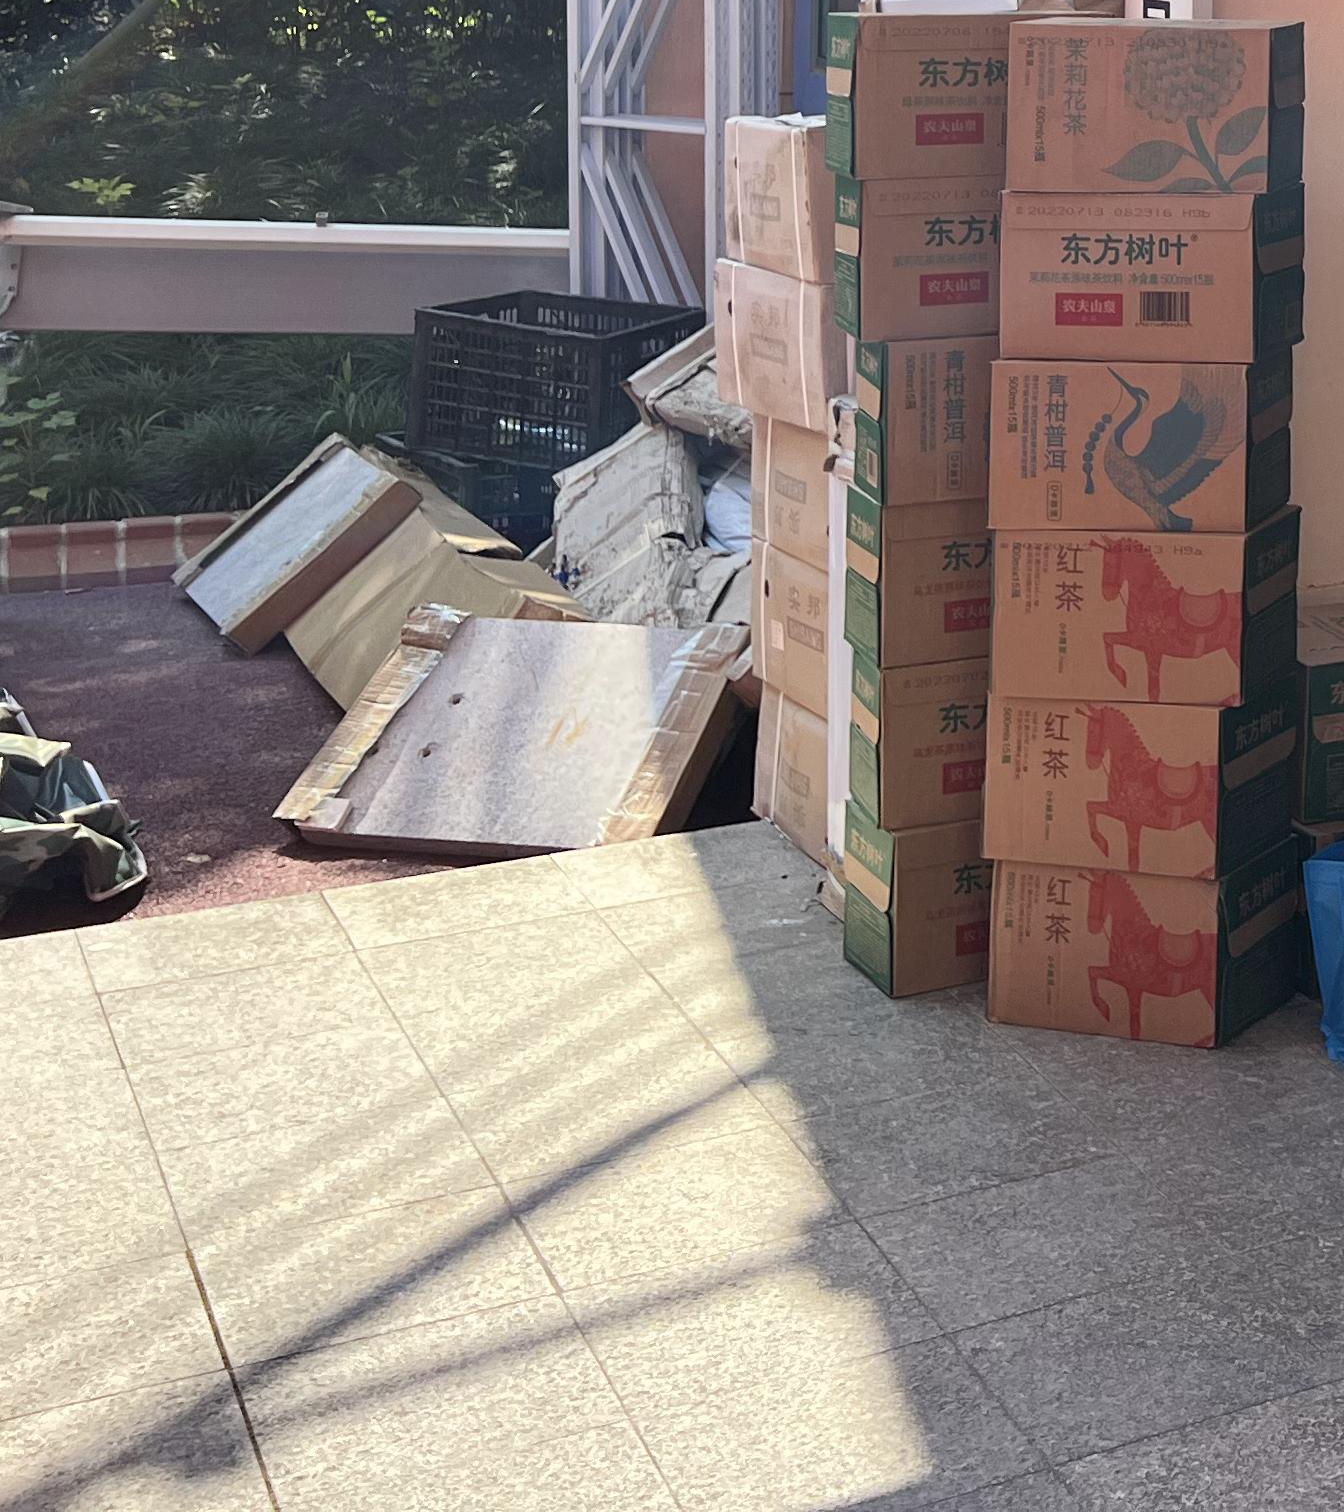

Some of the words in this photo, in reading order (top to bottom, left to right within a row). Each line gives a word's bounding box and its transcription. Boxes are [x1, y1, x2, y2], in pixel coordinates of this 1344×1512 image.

[1063, 38, 1088, 136] 茉莉花茶
[1061, 233, 1189, 266] 东方树叶
[1062, 299, 1117, 314] 农夫山泉
[1044, 374, 1069, 473] 青柑普洱
[1055, 544, 1086, 612] 红茶
[1042, 711, 1070, 779] 红茶
[1045, 876, 1072, 944] 红茶
